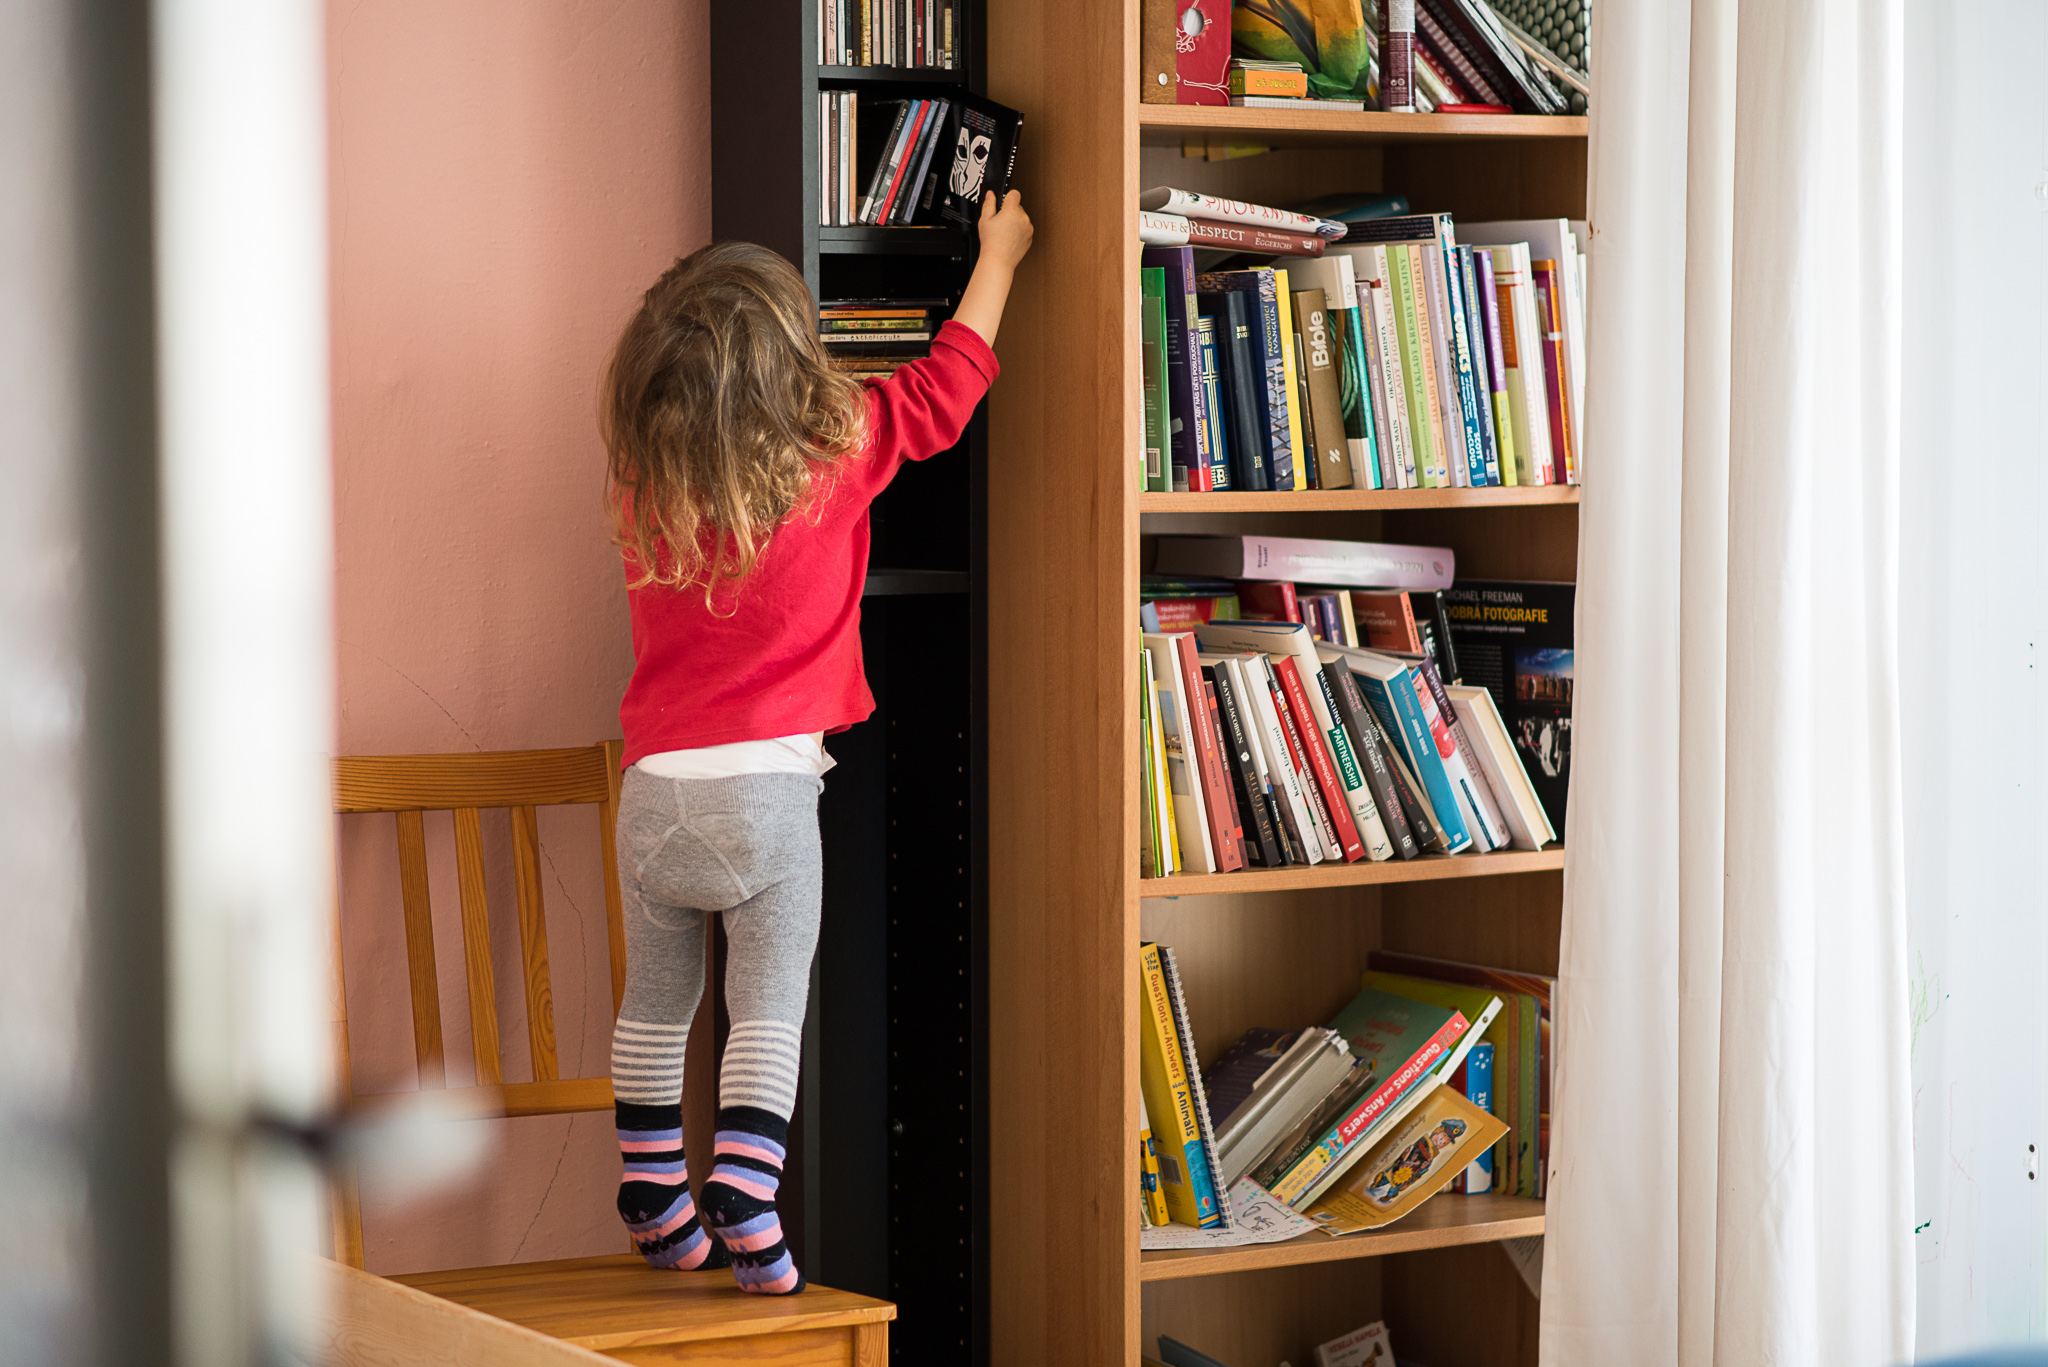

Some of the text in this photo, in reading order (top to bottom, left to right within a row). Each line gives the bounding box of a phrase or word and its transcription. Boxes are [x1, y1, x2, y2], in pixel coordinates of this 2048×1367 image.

[1256, 78, 1266, 87] 24
[1143, 214, 1245, 241] LOVE & RESPECT
[1255, 237, 1293, 250] EGGERICHS
[1413, 257, 1423, 299] OBJEKTY
[1448, 252, 1462, 308] MAKING
[1264, 305, 1275, 356] PROVOKUJÍCÍ
[1268, 306, 1278, 353] EVANGELIA
[1309, 311, 1328, 366] Bible
[1379, 256, 1405, 416] ZÁKLADY FIGURÁLNÍ KRESBY
[1400, 259, 1423, 394] ZÁKLADY KRESBY KRAJINY
[1419, 312, 1429, 343] ZÁTIŠÍ
[1454, 311, 1471, 372] COMICS
[1385, 359, 1393, 398] OKAMŽIK
[1425, 347, 1433, 381] KRESBY
[1428, 385, 1439, 423] ZÁKLADY
[1466, 426, 1477, 468] McCLOUD
[1473, 432, 1482, 459] SCOTT
[1444, 590, 1523, 602] MICHAEL FREEMAN
[1446, 604, 1548, 622] DOBRÁ FOTOGRAFIE
[1192, 672, 1200, 697] MATOUŠE
[1287, 670, 1296, 686] nimi
[1426, 667, 1453, 722] Pavel Hošek
[1222, 679, 1243, 743] WAYNE JACOBSEN
[1296, 693, 1309, 721] rosteme
[1317, 671, 1341, 724] RECREATING
[1201, 715, 1210, 749] EVANGELIUM
[1284, 711, 1293, 729] MYSLI
[1308, 728, 1316, 741] děti
[1292, 735, 1300, 749] TĚLA
[1333, 729, 1358, 786] PARTNERSHIP
[1460, 746, 1477, 772] dobrých
[1298, 750, 1312, 779] ZKLIDNĚNÍ
[1314, 742, 1332, 786] Vychováváme
[1288, 768, 1299, 796] Kristus
[1404, 790, 1413, 805] Marie
[1249, 771, 1272, 841] MILUJE MĚ!
[1314, 793, 1327, 821] MEDITACE
[1387, 799, 1397, 818] RUTH
[1388, 785, 1405, 826] SOUKUPOVÁ
[1272, 800, 1291, 851] Andrew Wommack
[1324, 821, 1335, 843] RYCHLÉ
[1151, 974, 1167, 1023] Questions
[1165, 1036, 1180, 1078] Answers
[1393, 1043, 1439, 1088] Questions
[1172, 1079, 1186, 1088] about
[1383, 1086, 1393, 1097] and
[1177, 1091, 1194, 1136] Animals
[1344, 1096, 1384, 1135] Answers
